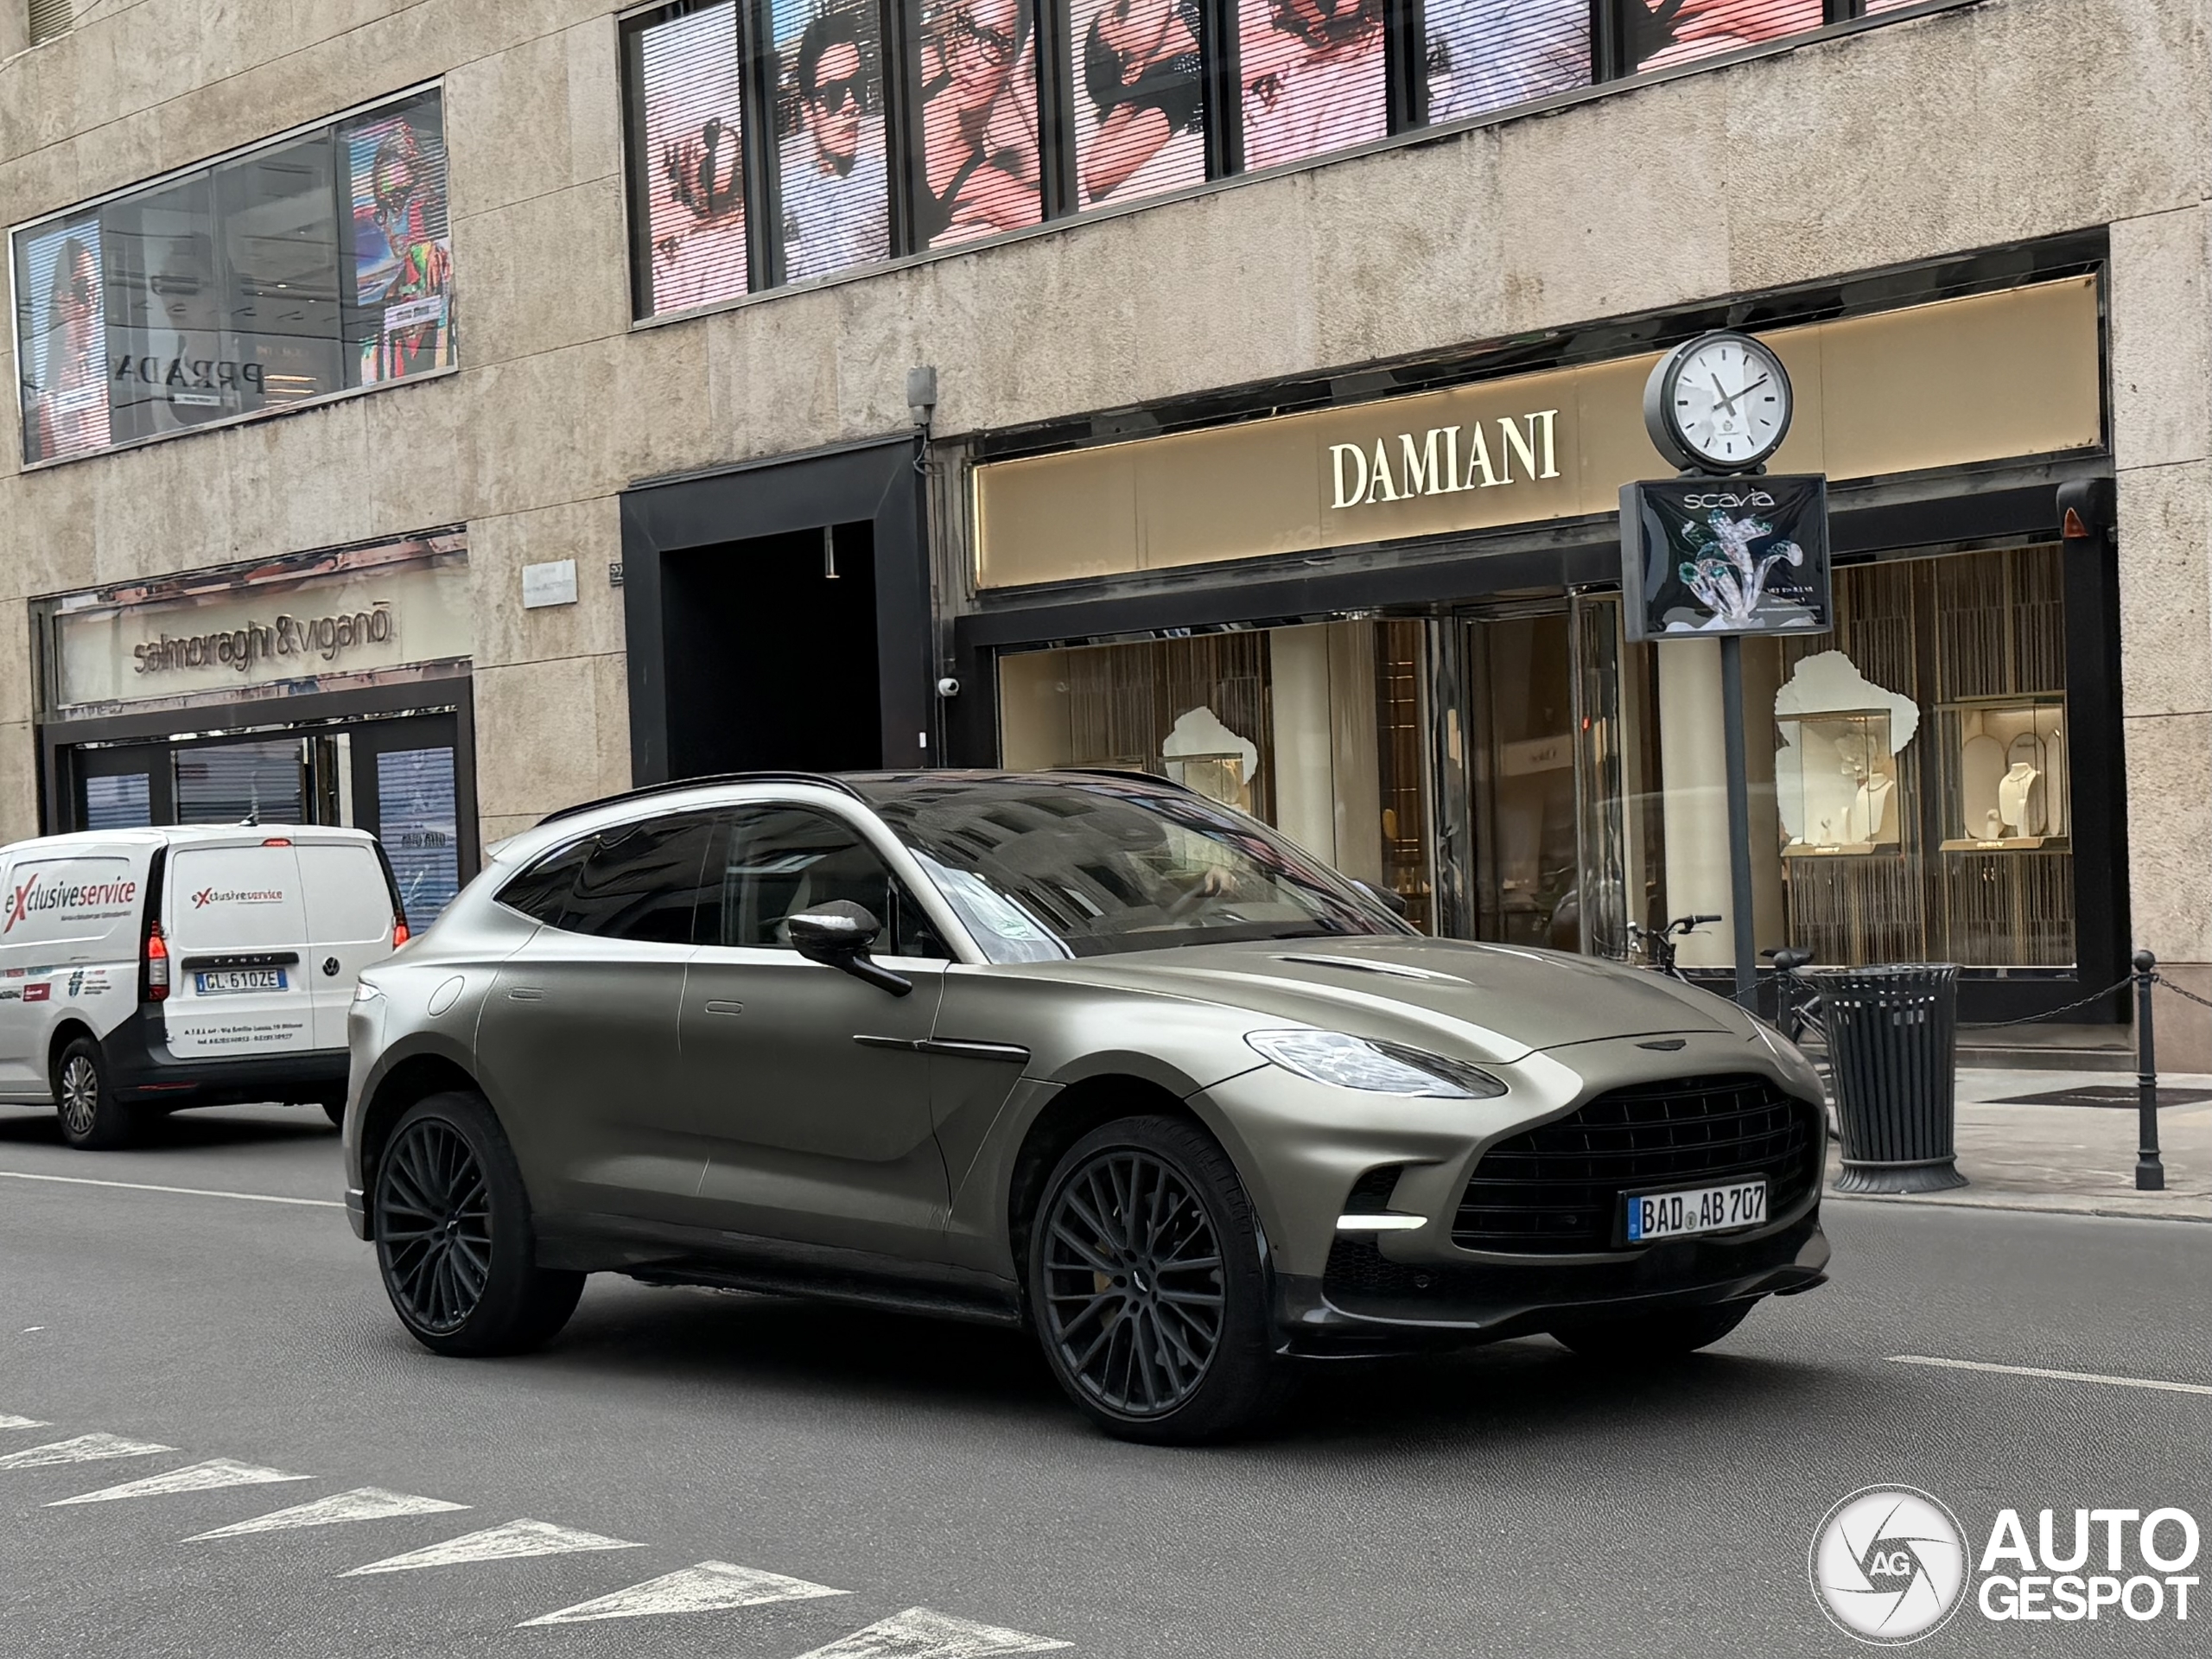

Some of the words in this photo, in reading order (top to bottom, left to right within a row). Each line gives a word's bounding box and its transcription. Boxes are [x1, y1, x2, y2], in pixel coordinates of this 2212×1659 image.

[1329, 410, 1560, 509] DAMIANI
[1683, 488, 1775, 509] scavia
[1642, 1196, 1683, 1234] BAD
[1700, 1191, 1725, 1228] AB
[1730, 1185, 1764, 1223] 707
